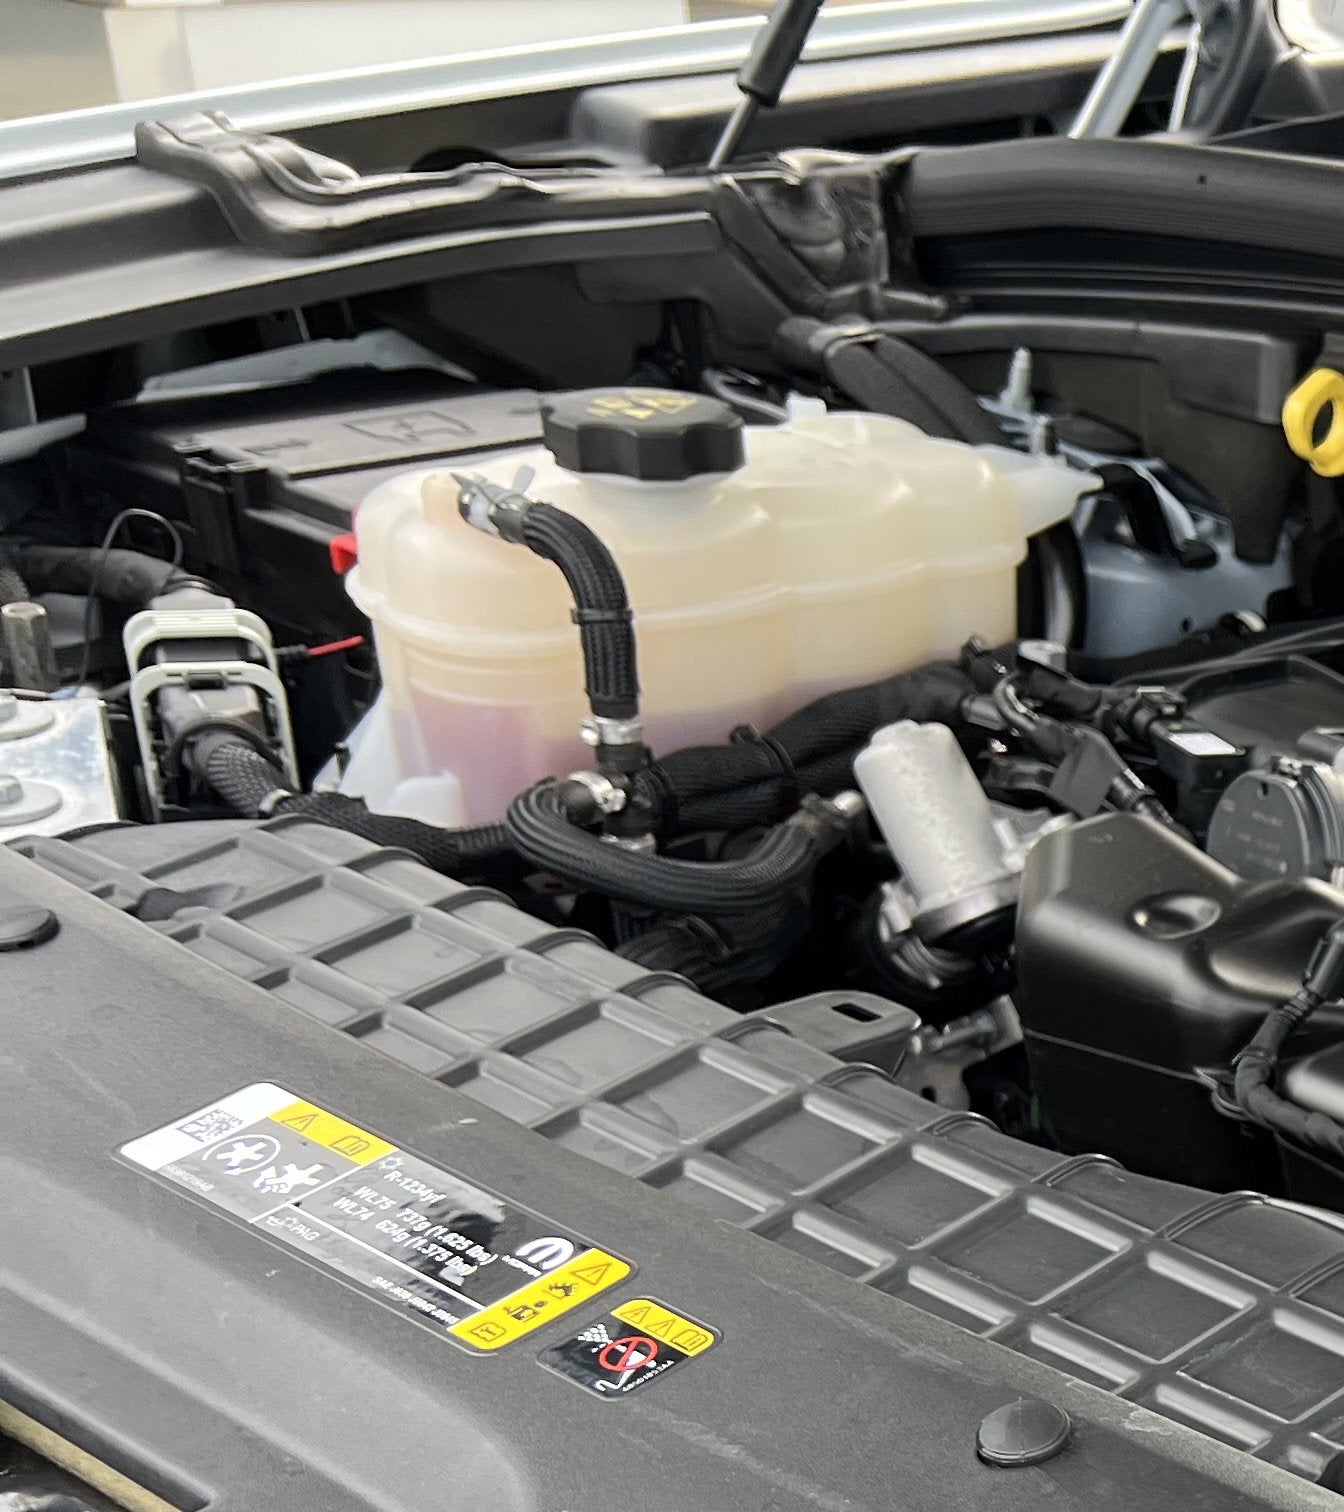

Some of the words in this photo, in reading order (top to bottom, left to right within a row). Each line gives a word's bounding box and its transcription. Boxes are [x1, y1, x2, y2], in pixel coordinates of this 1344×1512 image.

[383, 1170, 447, 1204] R-1234yf
[289, 1222, 321, 1241] PAG
[333, 1196, 375, 1221] WL74
[375, 1219, 411, 1243] 624g
[404, 1236, 453, 1262] (1.375
[445, 1255, 478, 1277] lbs)
[353, 1186, 396, 1210] WL75
[396, 1207, 432, 1232] 737g
[424, 1225, 474, 1251] (1.625
[465, 1243, 498, 1266] lbs)
